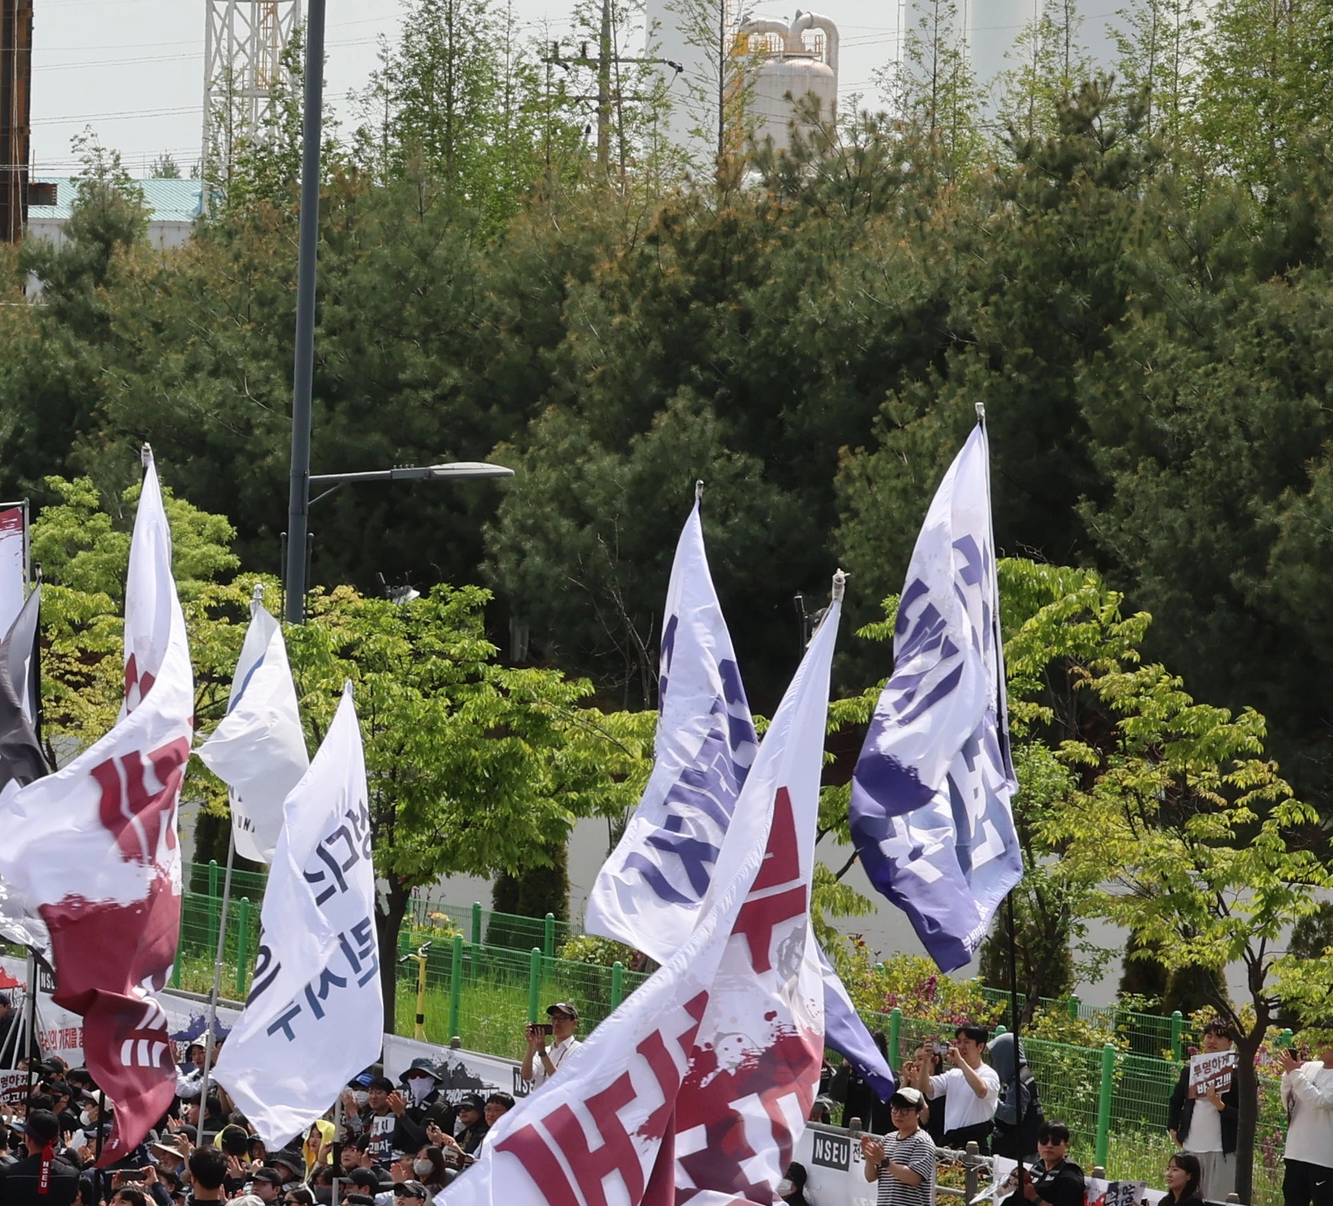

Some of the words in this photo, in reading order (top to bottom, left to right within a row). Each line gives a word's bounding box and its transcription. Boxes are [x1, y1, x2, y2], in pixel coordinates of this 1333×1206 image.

[1193, 1054, 1235, 1075] 투명하게
[815, 1138, 850, 1171] NSEU
[41, 1161, 49, 1189] NSEU
